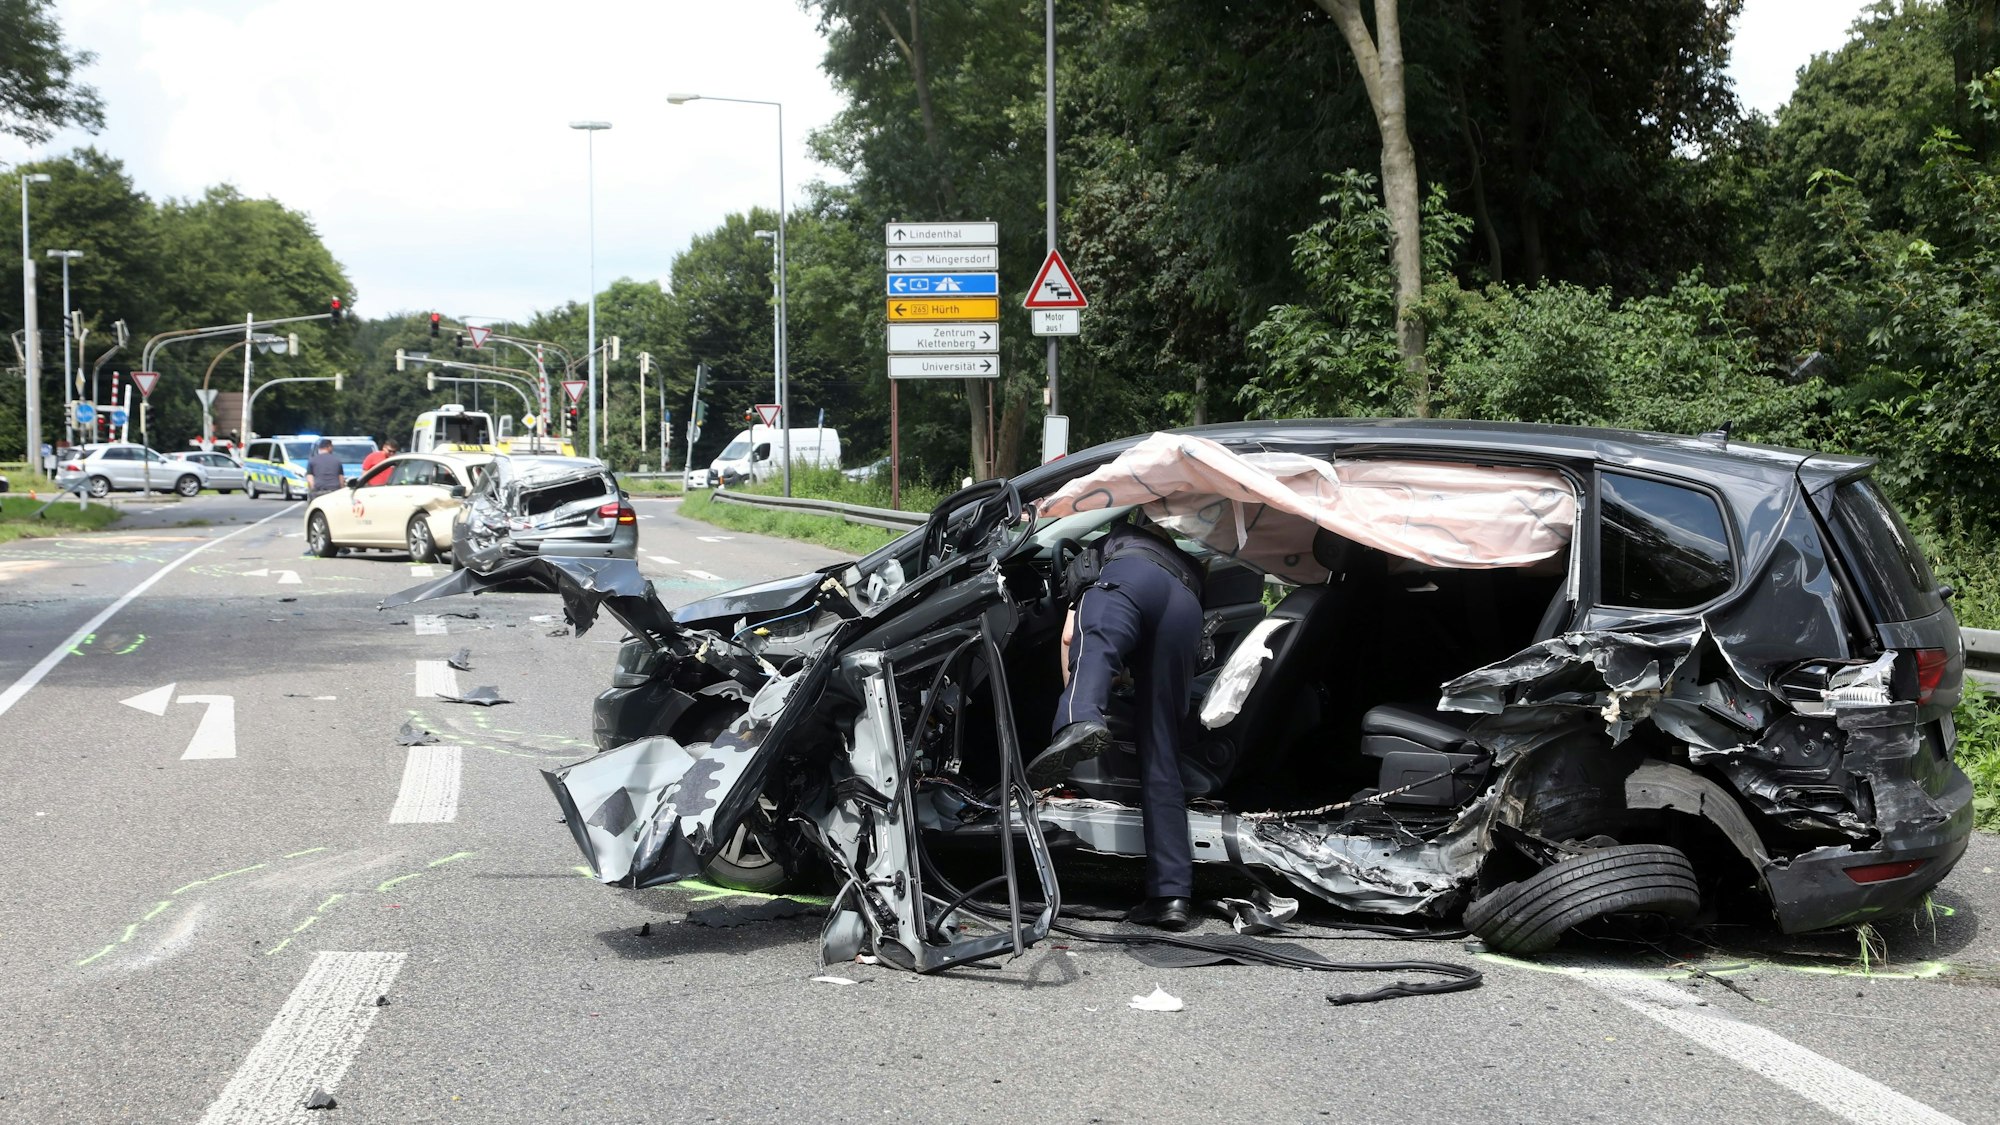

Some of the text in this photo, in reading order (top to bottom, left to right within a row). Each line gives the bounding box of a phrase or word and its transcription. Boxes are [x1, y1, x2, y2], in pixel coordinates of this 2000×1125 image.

[909, 229, 962, 239] Lindenthal
[926, 254, 990, 265] Müngersdorf
[916, 280, 922, 288] 4
[913, 304, 960, 314] 265 Hürth
[1045, 312, 1065, 321] Motor
[1045, 323, 1062, 332] aus!
[933, 328, 976, 337] Zentrum
[917, 339, 976, 350] Klettenberg
[922, 362, 976, 371] Universität
